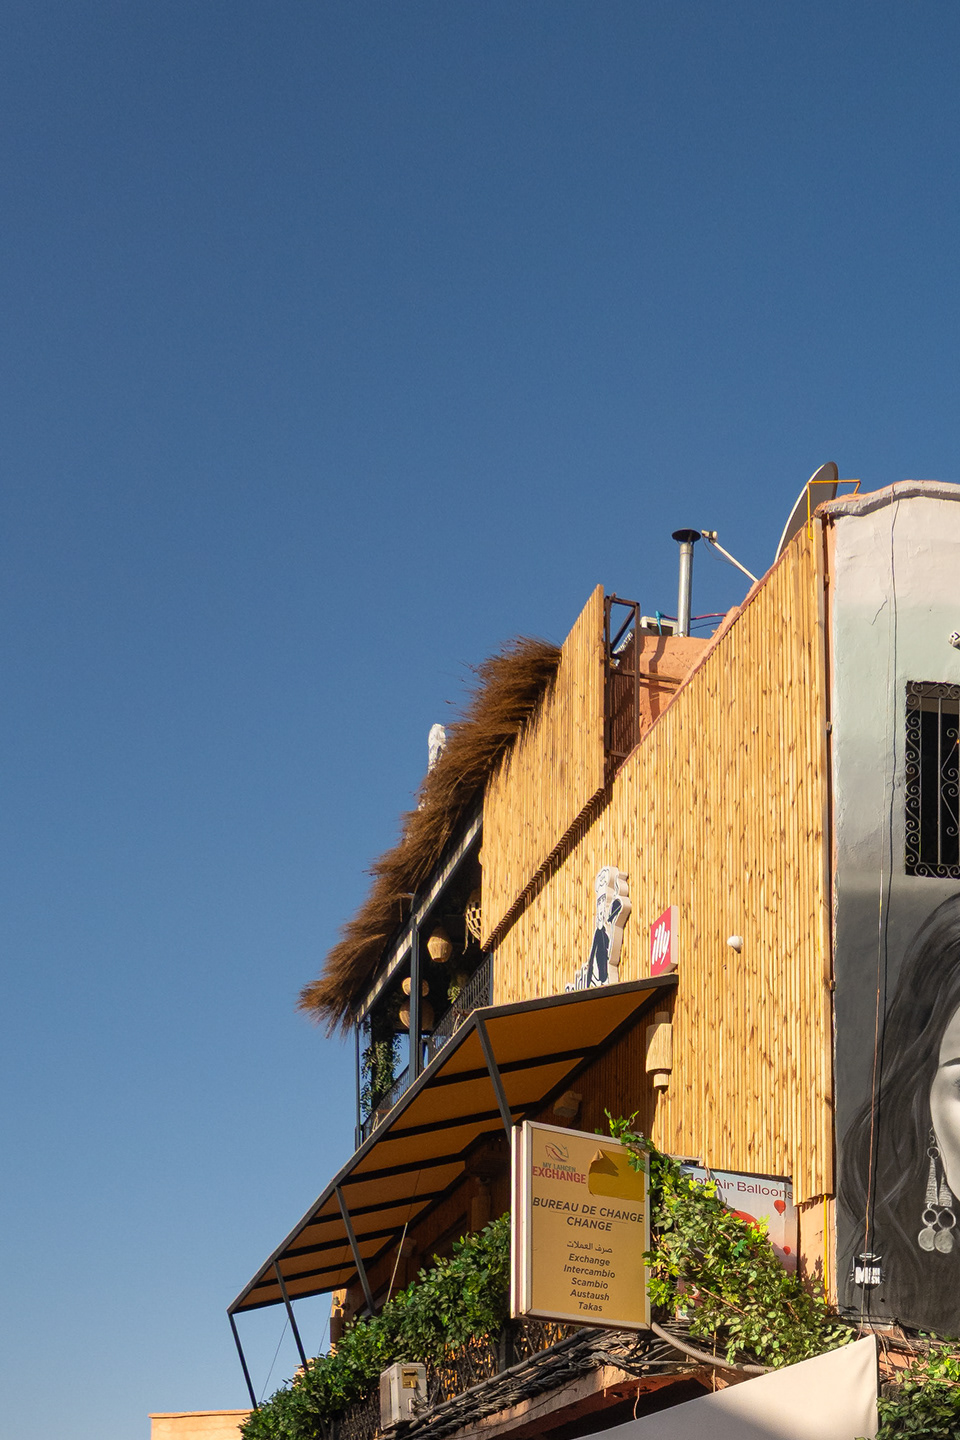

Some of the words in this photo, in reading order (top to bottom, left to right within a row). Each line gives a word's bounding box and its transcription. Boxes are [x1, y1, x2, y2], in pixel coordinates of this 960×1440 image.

[651, 921, 671, 965] illy
[532, 1165, 587, 1184] EXCHANGE
[714, 1178, 735, 1190] Air
[737, 1181, 793, 1200] Balloons
[532, 1197, 579, 1214] BUREAU
[582, 1205, 596, 1215] DE
[600, 1207, 644, 1223] CHANGE
[566, 1216, 613, 1232] CHANGE
[568, 1253, 611, 1267] Exchange
[563, 1264, 616, 1279] Intercambio
[571, 1277, 609, 1290] Scambio
[570, 1289, 610, 1301] Austaush
[578, 1301, 603, 1312] Takas
